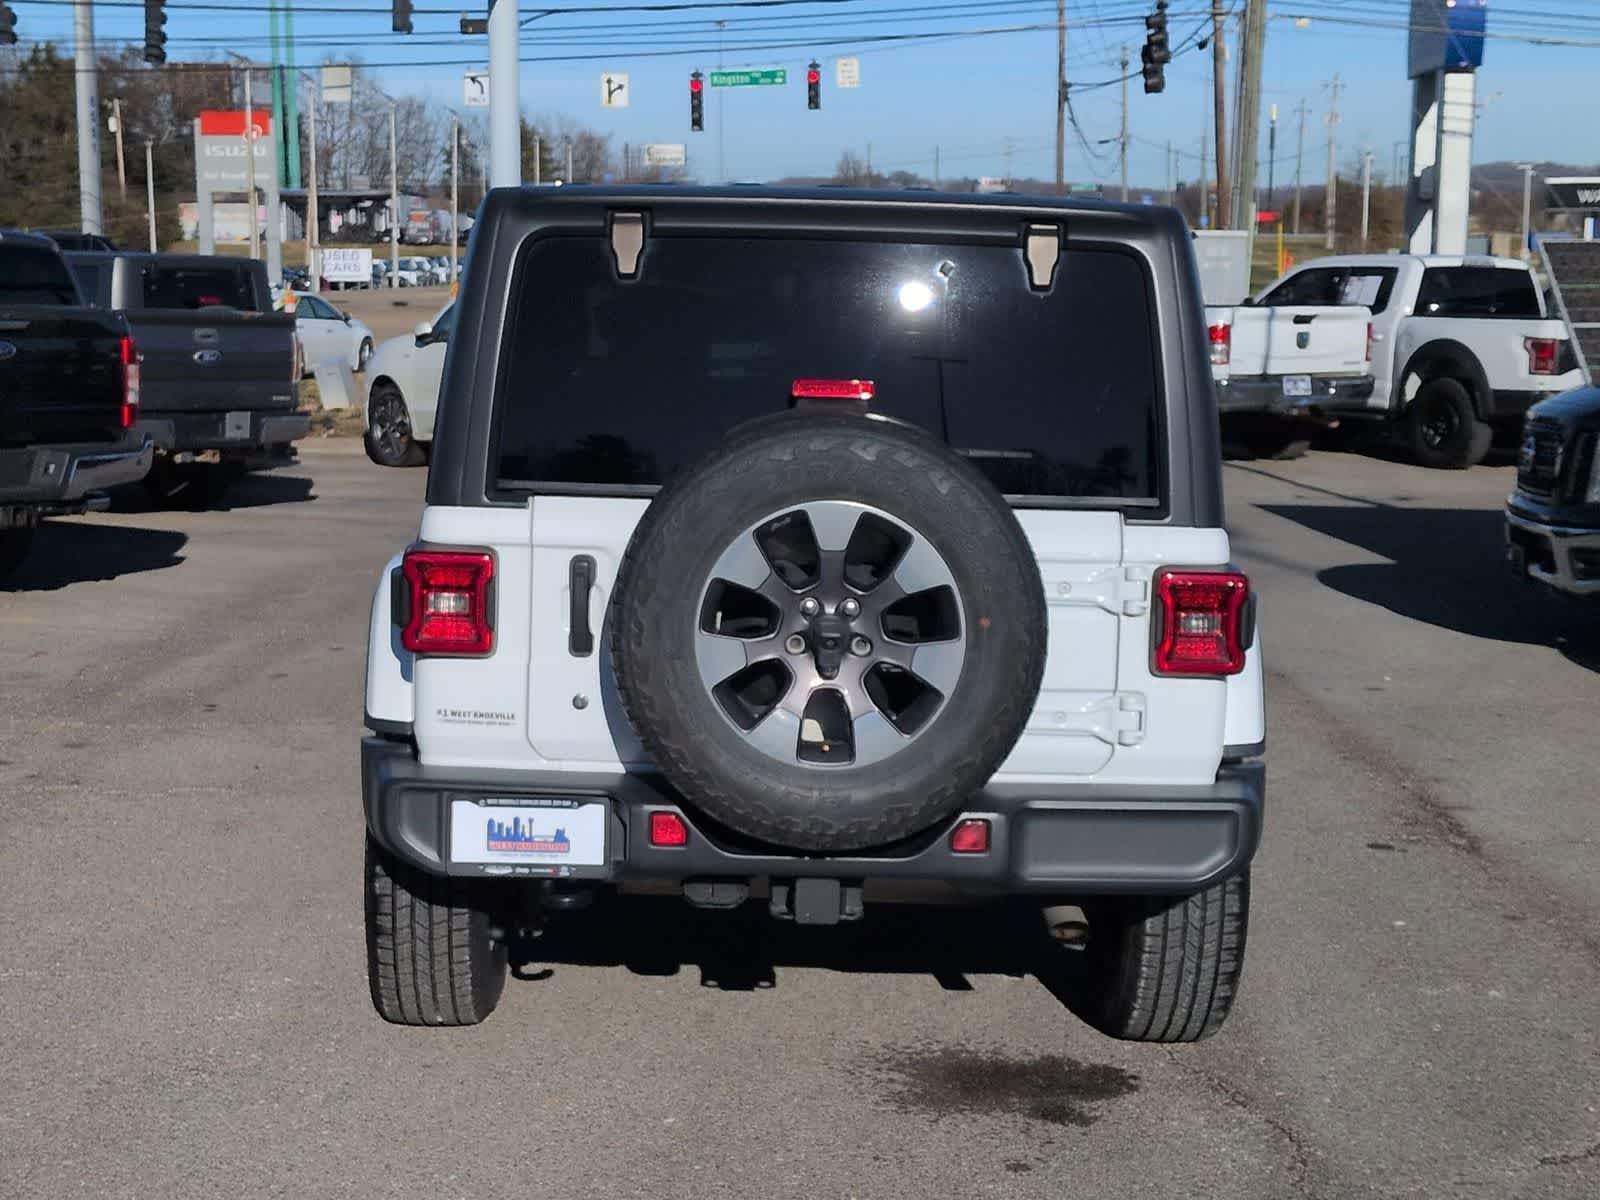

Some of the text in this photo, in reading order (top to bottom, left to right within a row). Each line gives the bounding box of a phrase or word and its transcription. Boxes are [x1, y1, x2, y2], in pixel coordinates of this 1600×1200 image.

[711, 75, 751, 86] Kingston
[321, 249, 360, 261] USED
[450, 710, 471, 719] WEST
[473, 711, 515, 720] KNOXVILLE
